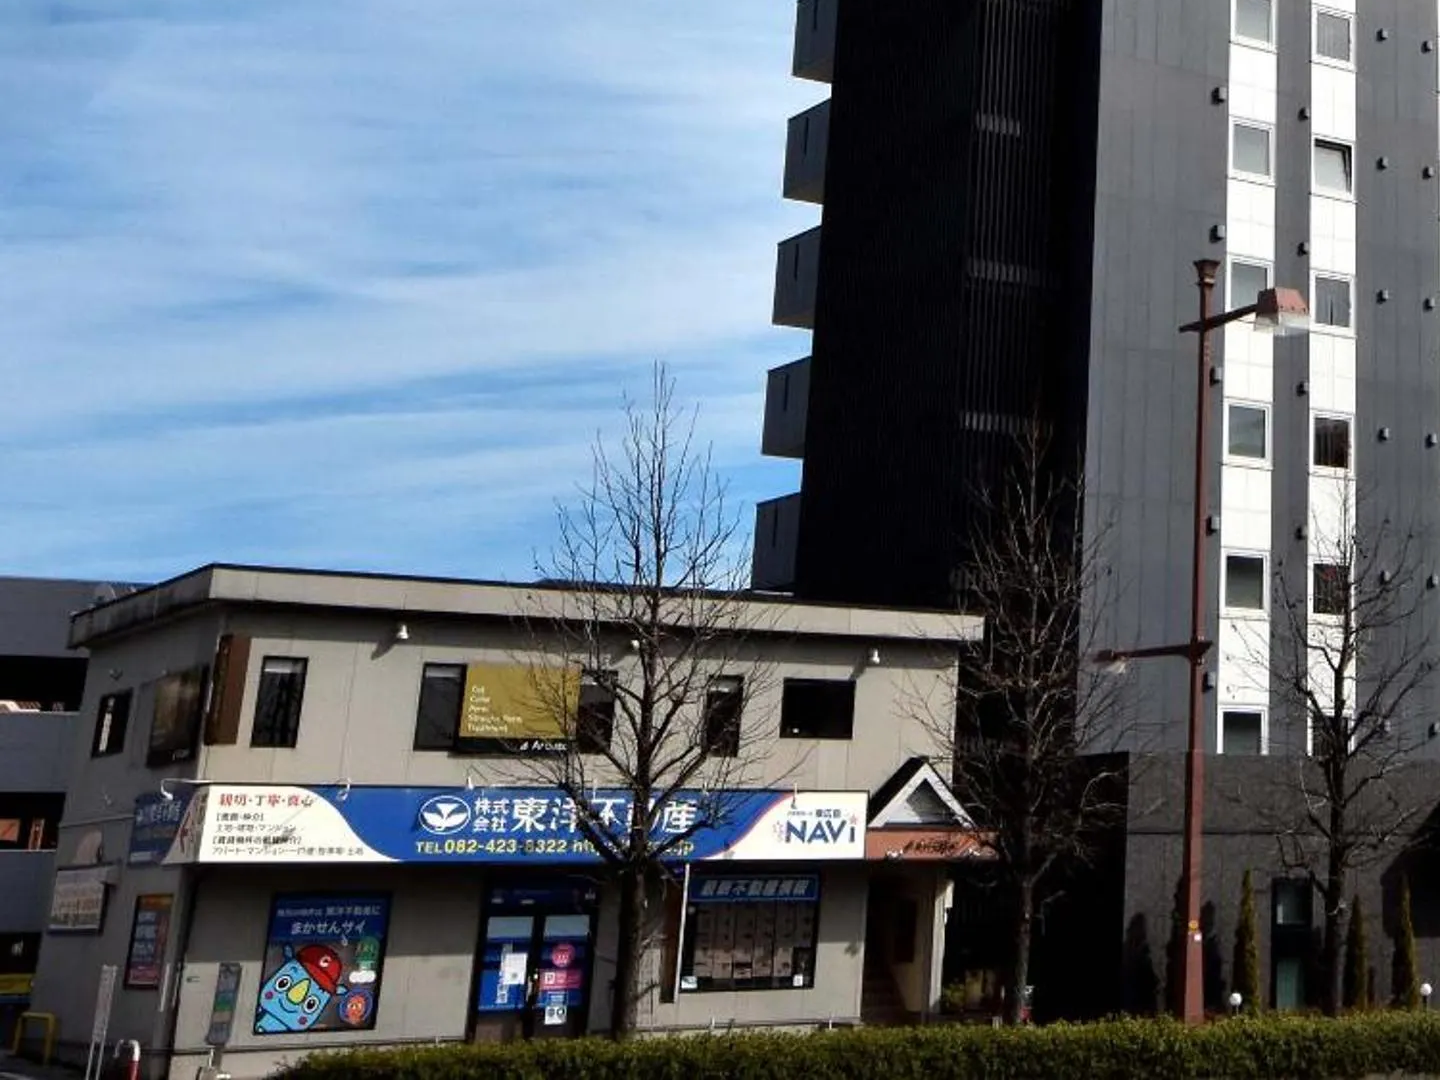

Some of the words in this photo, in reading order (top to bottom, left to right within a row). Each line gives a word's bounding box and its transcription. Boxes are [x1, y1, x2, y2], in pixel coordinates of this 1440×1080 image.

[475, 799, 510, 815] 株式
[473, 817, 507, 833] 会社
[416, 842, 442, 854] TEL
